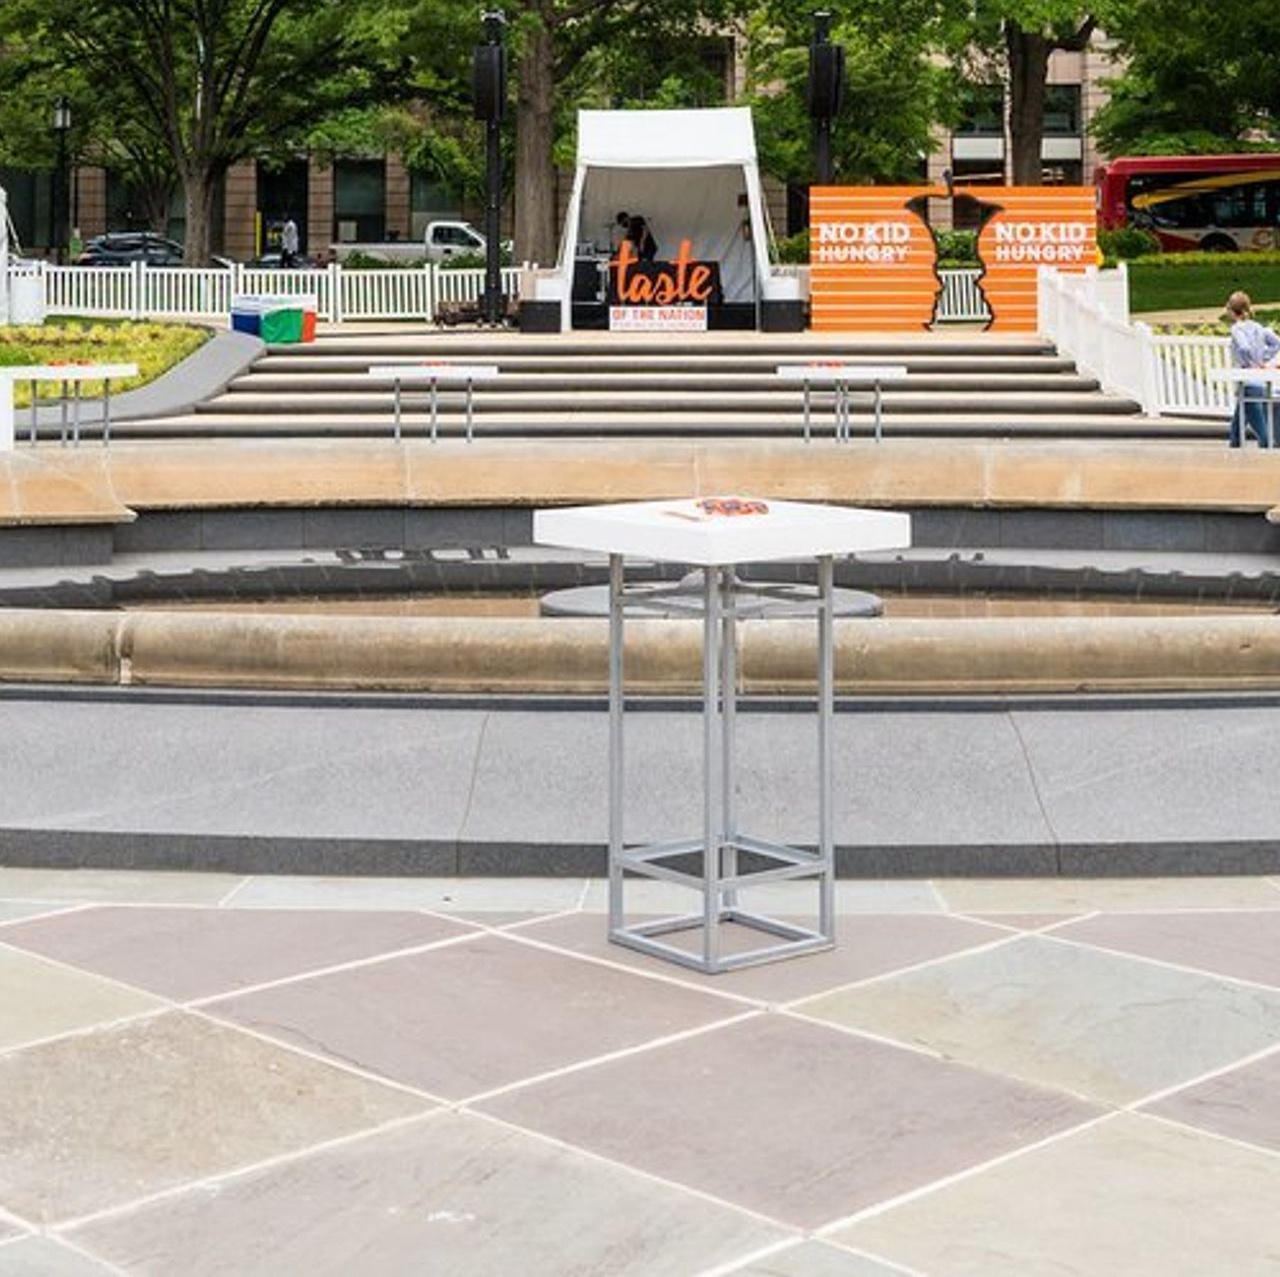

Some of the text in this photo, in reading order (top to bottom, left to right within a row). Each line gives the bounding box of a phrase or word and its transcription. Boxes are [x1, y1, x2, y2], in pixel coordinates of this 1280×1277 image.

[819, 223, 910, 243] NO KID
[995, 223, 1087, 243] NO KID
[819, 245, 909, 262] HUNGRY
[995, 245, 1085, 262] HUNGRY
[609, 239, 713, 305] taste
[658, 309, 706, 321] NATION
